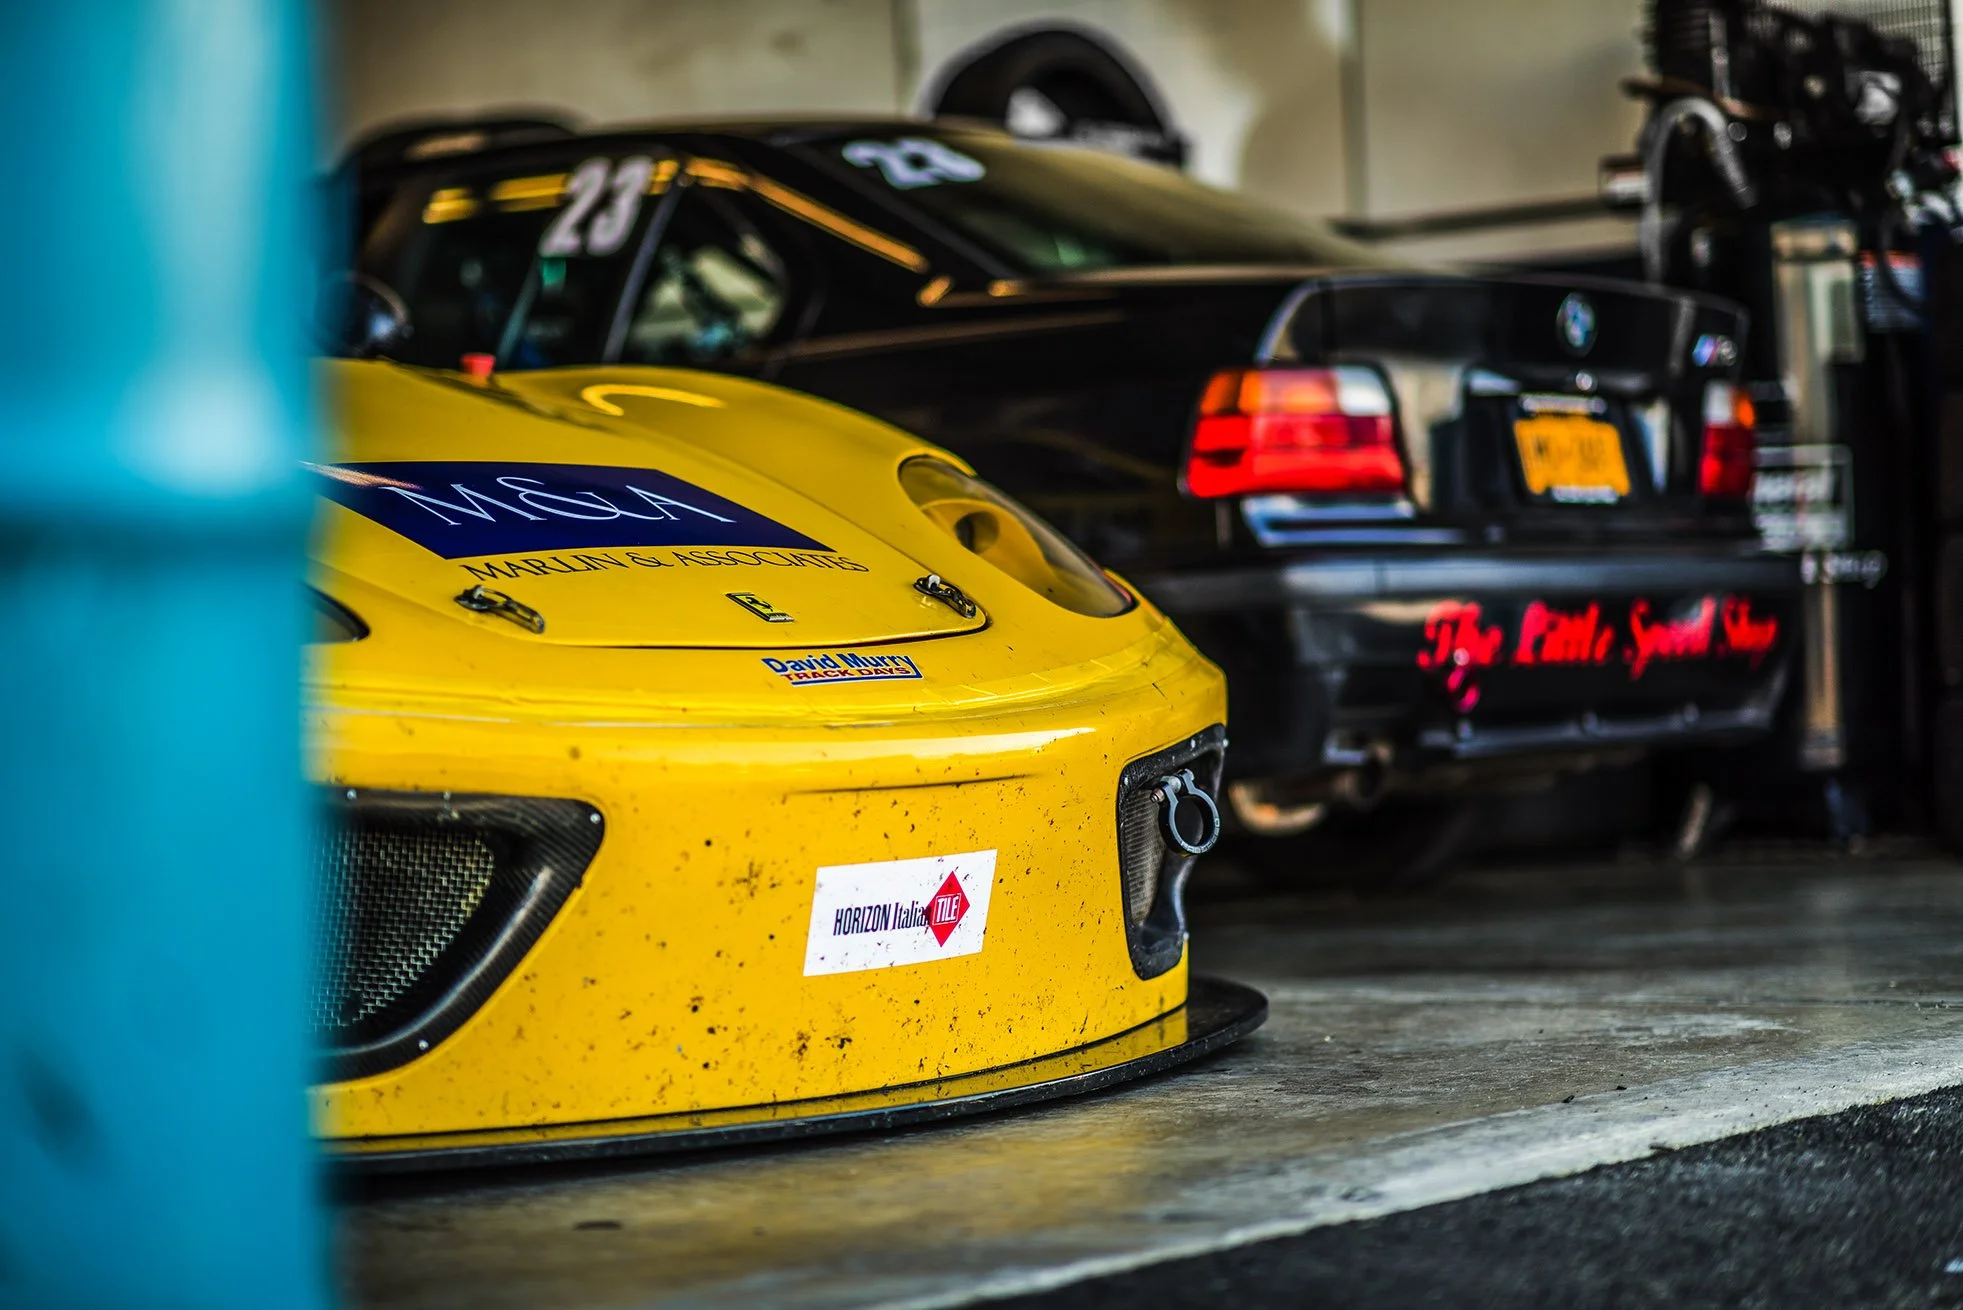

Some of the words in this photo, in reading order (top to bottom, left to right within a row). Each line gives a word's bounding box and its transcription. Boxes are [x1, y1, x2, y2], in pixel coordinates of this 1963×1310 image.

[540, 155, 654, 257] 23
[378, 476, 738, 525] M&A
[459, 552, 629, 581] MARLIN
[629, 551, 674, 568] &
[673, 550, 870, 573] ASSOCIATES
[761, 653, 841, 673] David
[836, 653, 916, 671] Murry
[780, 668, 855, 681] TRACK
[857, 666, 912, 677] DAYS
[1417, 599, 1503, 708] The
[833, 903, 892, 936] HORIZON
[936, 895, 960, 923] TILE
